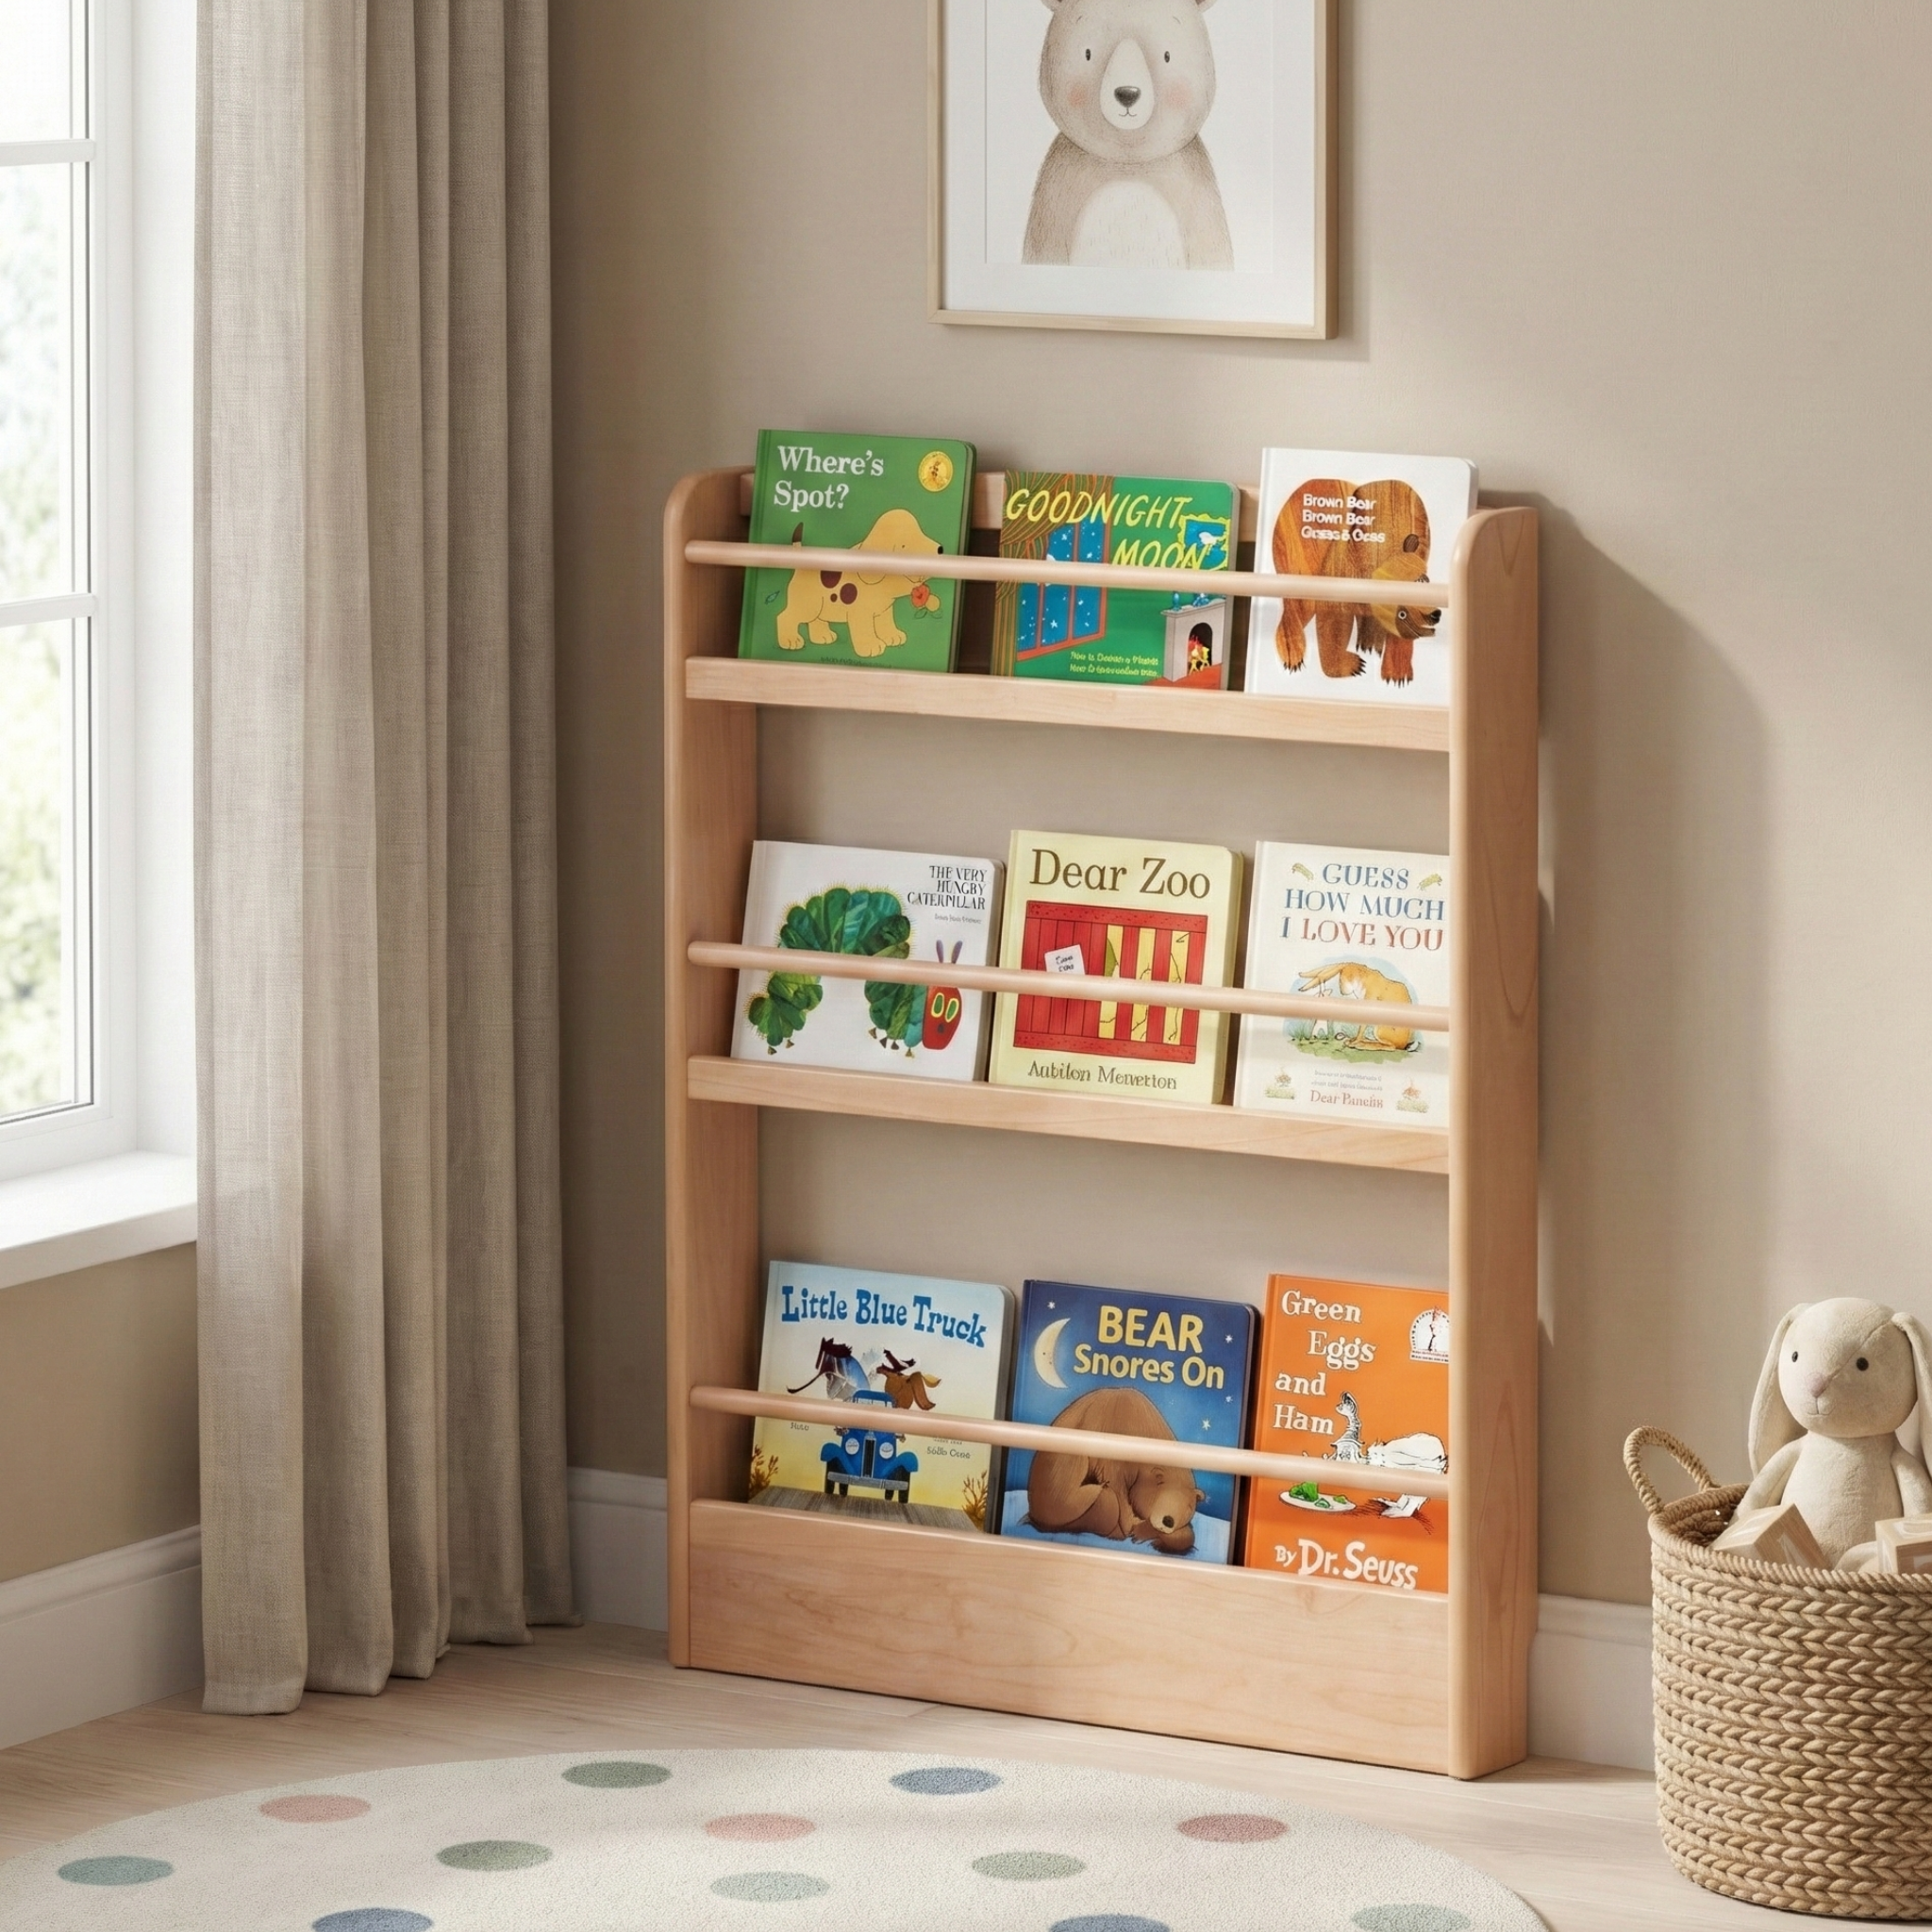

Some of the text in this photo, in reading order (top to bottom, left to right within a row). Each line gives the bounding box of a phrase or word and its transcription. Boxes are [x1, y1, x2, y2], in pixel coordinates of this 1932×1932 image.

[777, 445, 884, 476] Where's
[774, 479, 849, 512] Spot?
[1006, 489, 1192, 529] GOODNIGHT
[1303, 493, 1376, 510] Brown Bear
[1302, 509, 1375, 525] Brown Bear
[1111, 539, 1209, 570] MOON
[929, 865, 987, 882] THE VERY
[1029, 848, 1210, 899] Dear Zoo
[1323, 863, 1409, 890] GUESS
[1284, 889, 1445, 921] HOW MUCH
[1279, 916, 1443, 951] I LOVE YOU
[781, 1285, 987, 1348] Little Blue Truck
[1281, 1290, 1361, 1323] Green
[1097, 1305, 1205, 1354] BEAR
[1073, 1343, 1224, 1390] Snores On
[1307, 1330, 1376, 1371] Eggs
[1274, 1372, 1326, 1396] and
[1273, 1404, 1334, 1435] Ham
[1274, 1538, 1418, 1590] By Dr. Seuss
